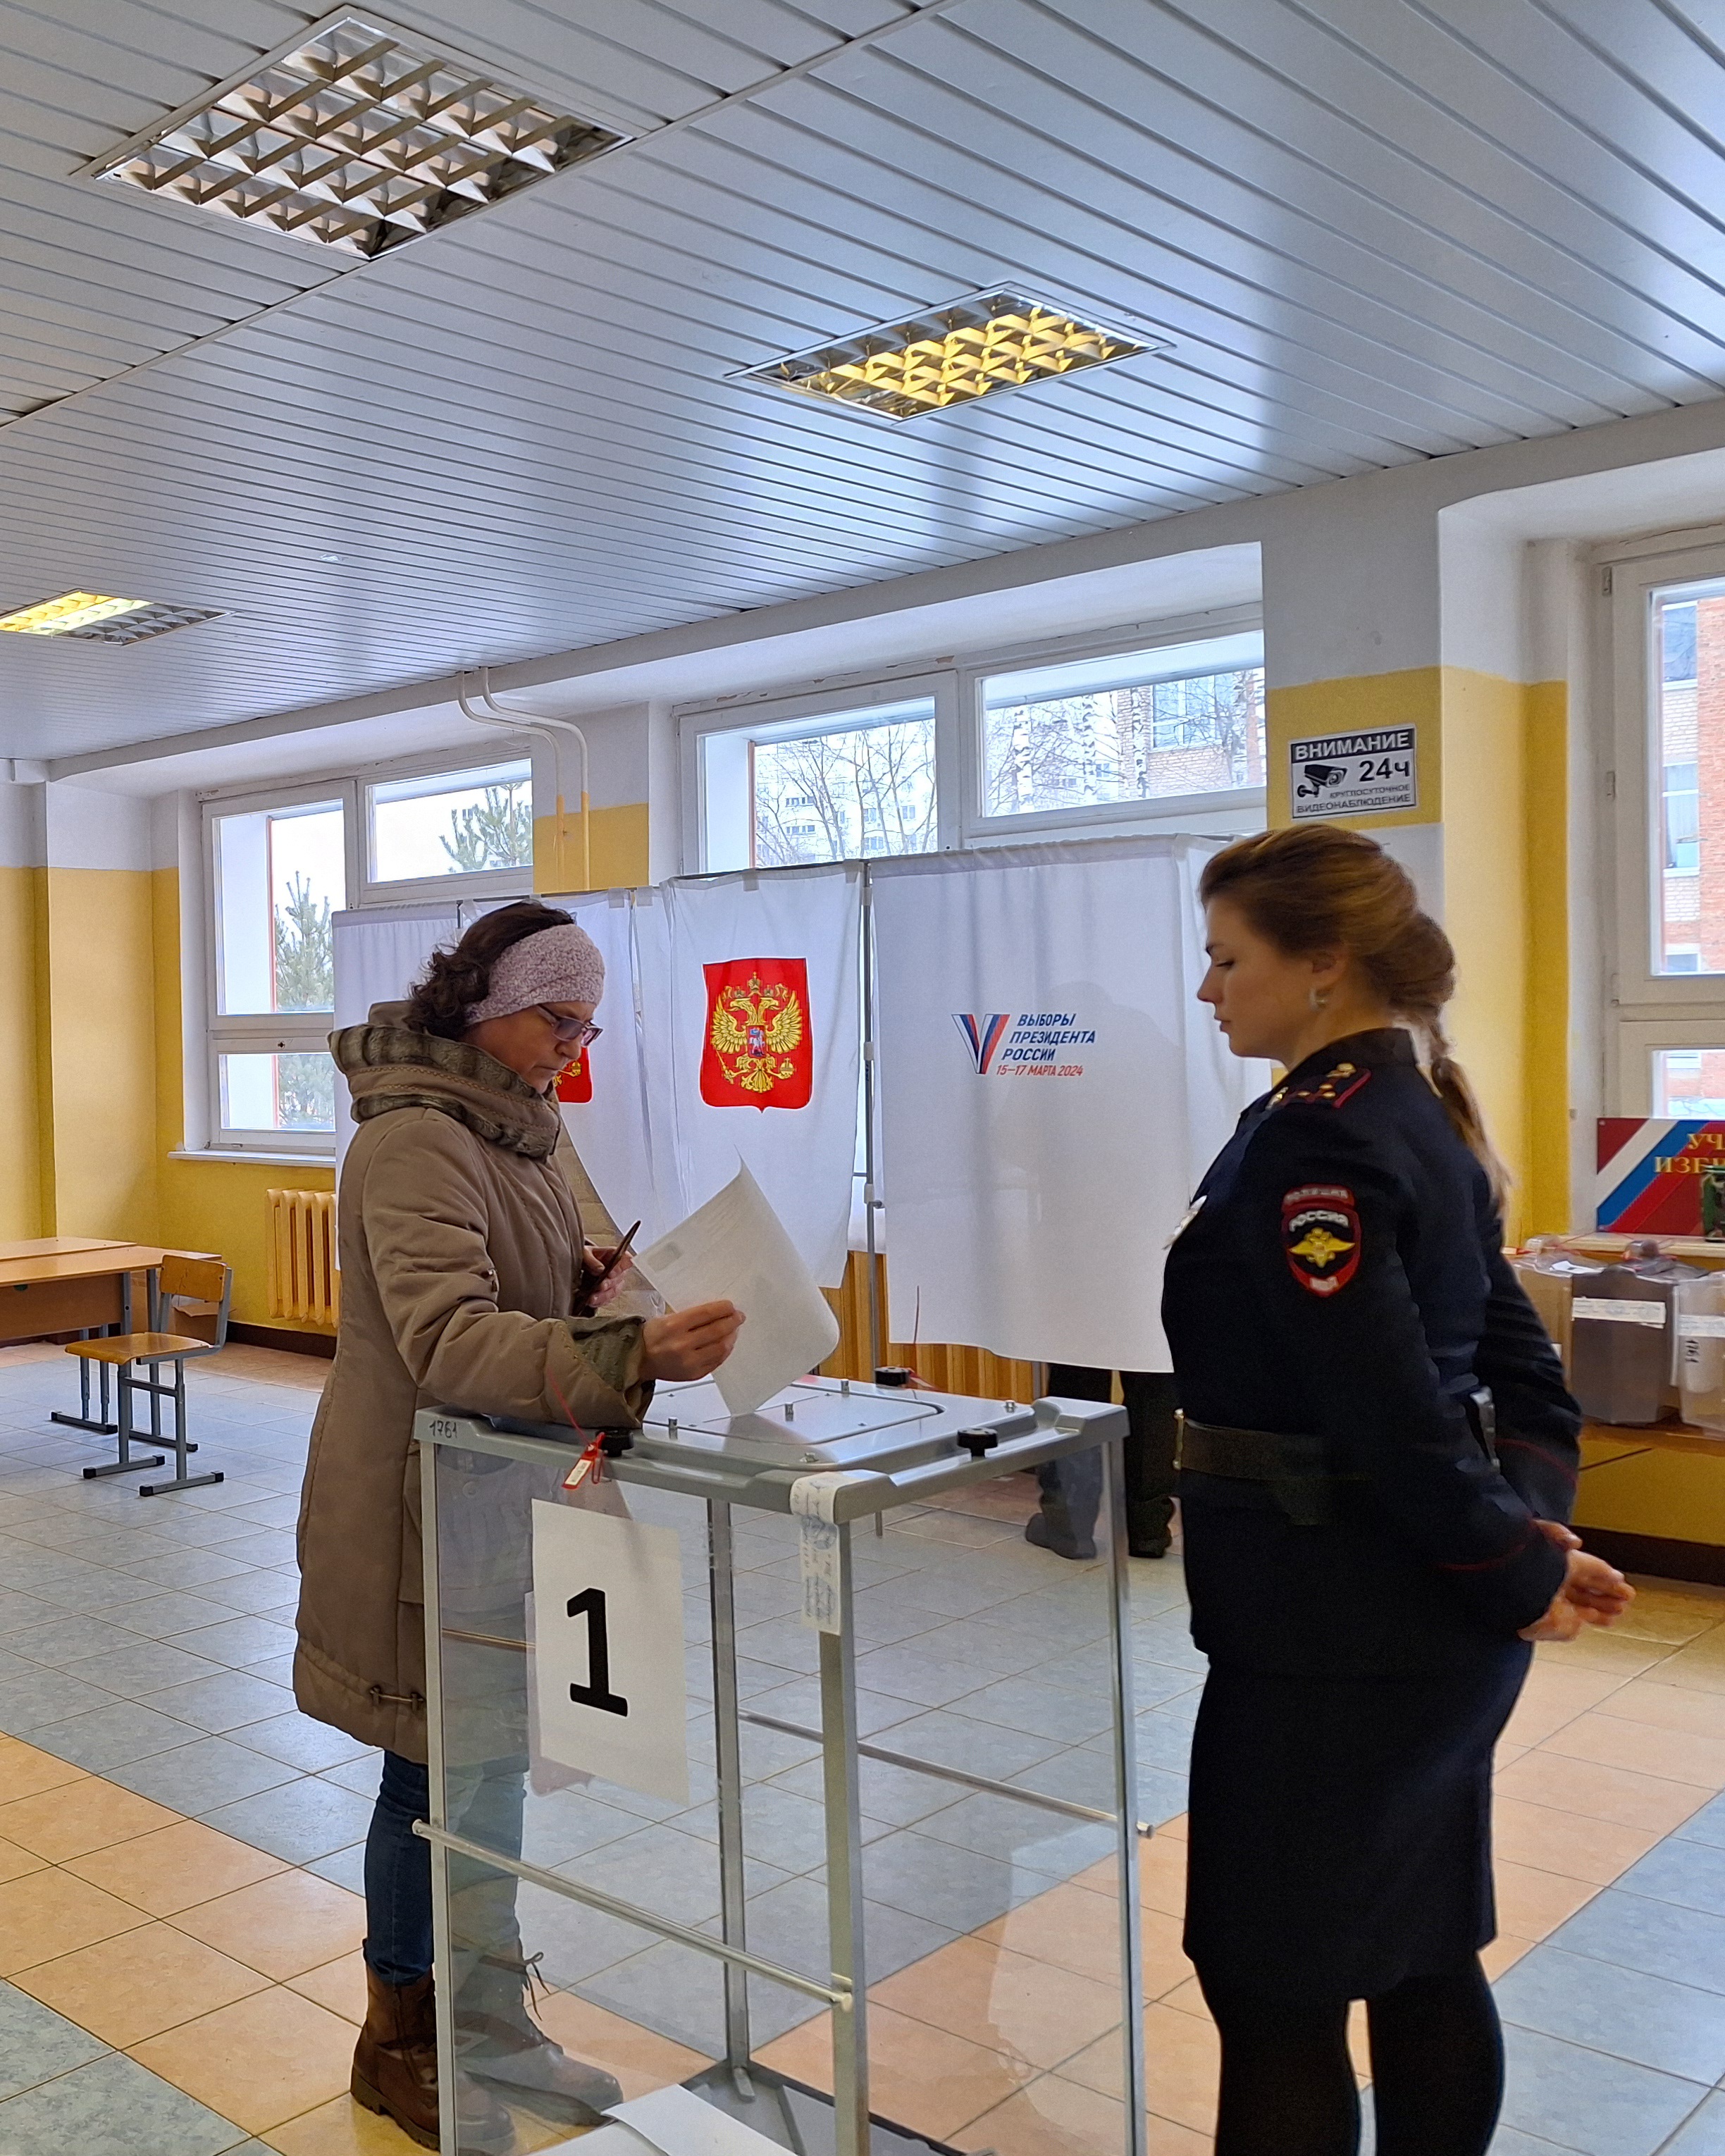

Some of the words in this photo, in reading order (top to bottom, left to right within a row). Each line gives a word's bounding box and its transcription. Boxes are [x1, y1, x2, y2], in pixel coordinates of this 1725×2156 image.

[1295, 731, 1409, 760] ВНИМАНИЕ
[1330, 784, 1410, 798] КРУГЛОСУТОЧНОЕ
[1297, 793, 1411, 813] ВИДЕОНАБЛЮДЕНИЕ
[1017, 1013, 1077, 1027] ВЫБОРЫ
[1009, 1031, 1096, 1046] ПРЕЗИДЕНТА
[1001, 1048, 1056, 1061] РОССИИ
[1027, 1065, 1056, 1076] МАРТА
[1057, 1065, 1084, 1077] 2024
[429, 1420, 457, 1438] 1761
[567, 1587, 628, 1717] 1
